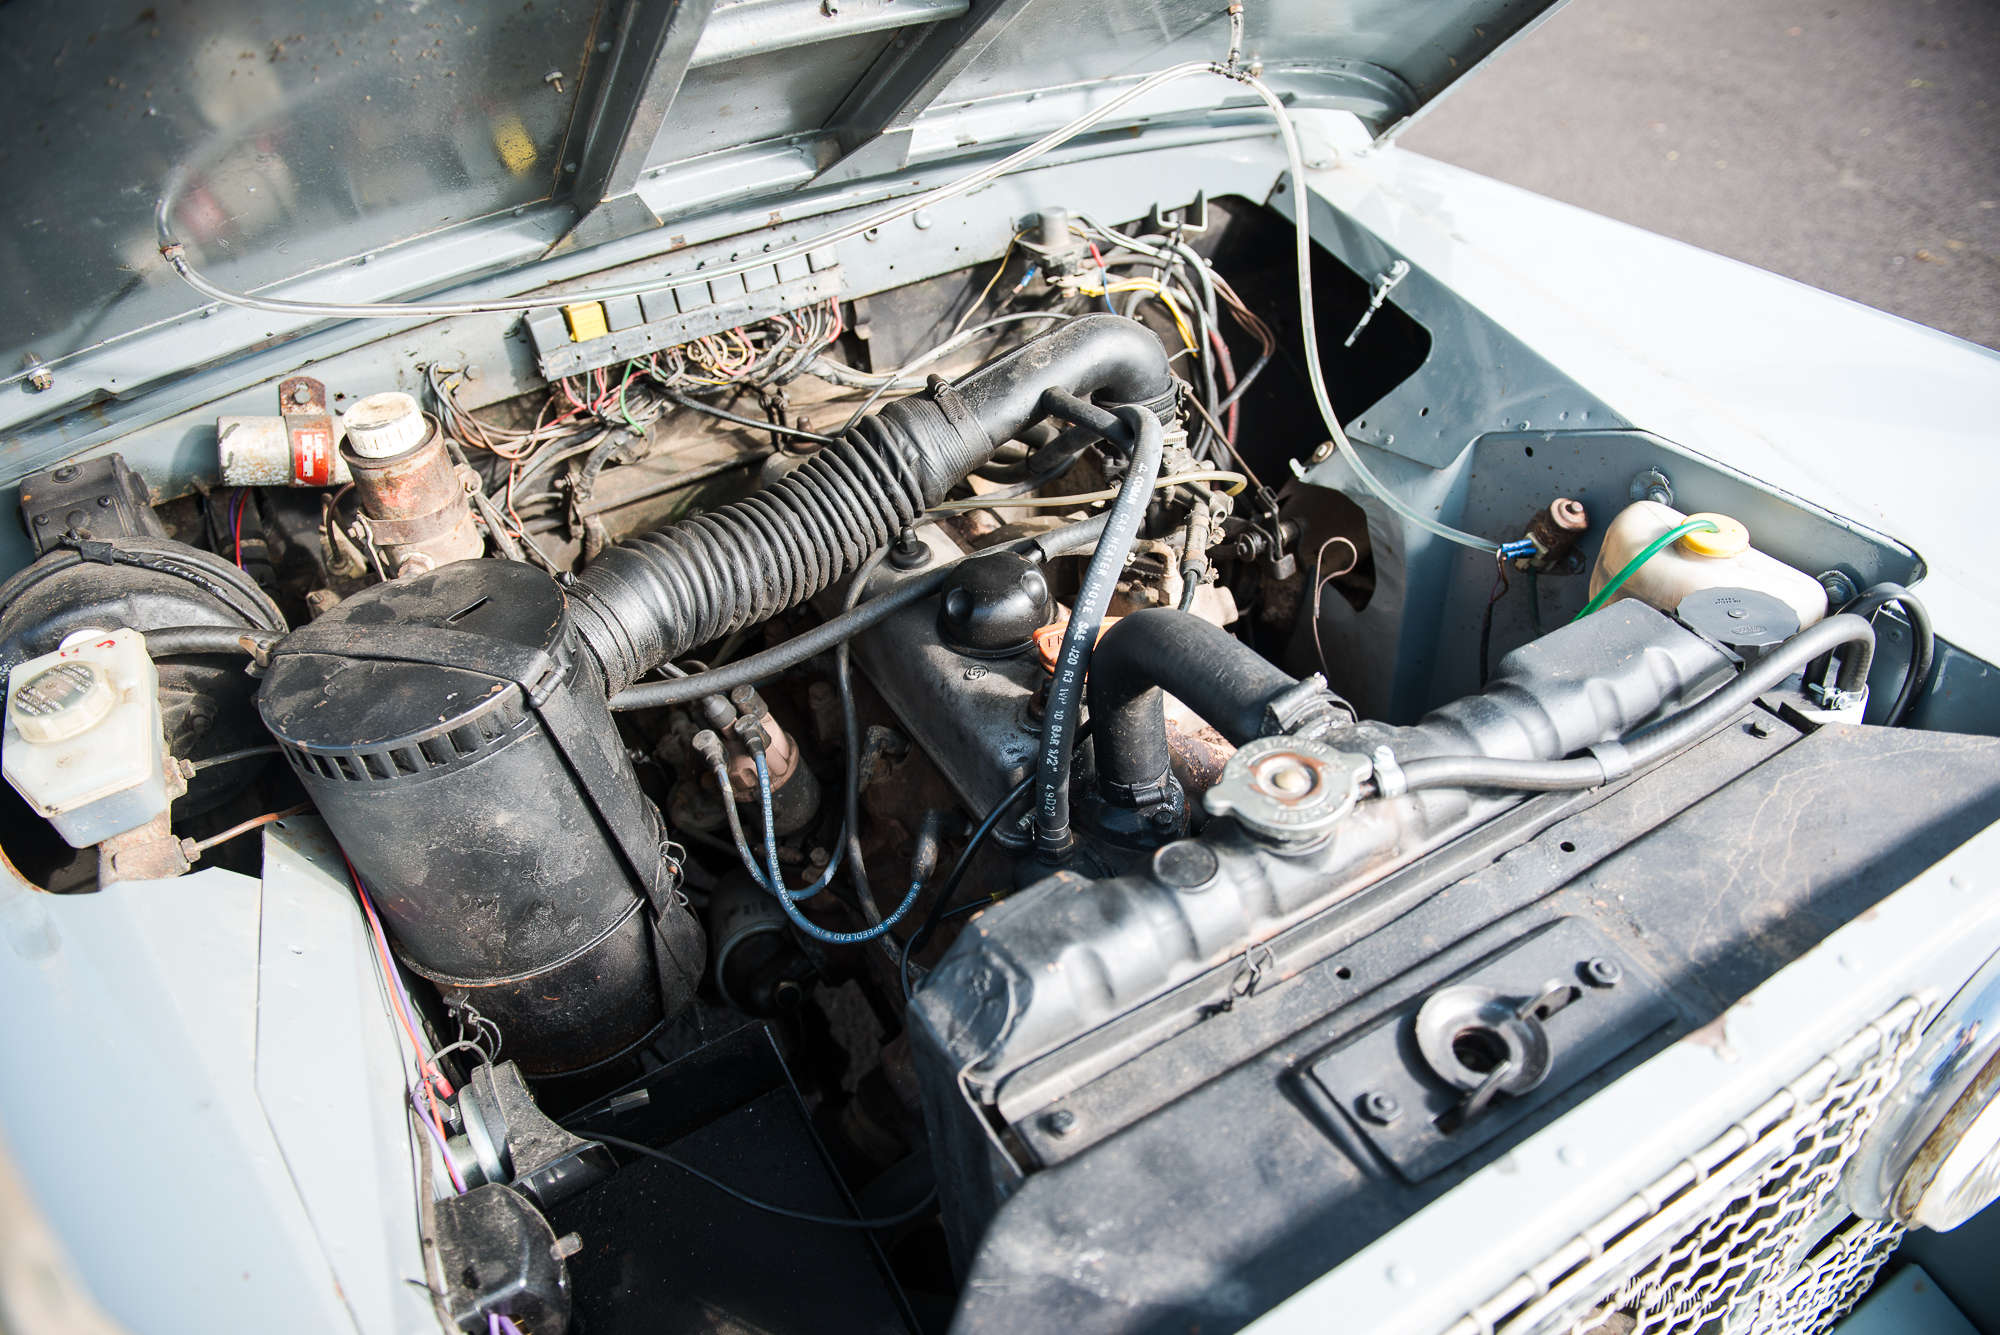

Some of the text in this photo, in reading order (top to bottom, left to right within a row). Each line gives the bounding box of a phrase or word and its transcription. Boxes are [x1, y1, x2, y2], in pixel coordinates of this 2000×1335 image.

[1116, 513, 1130, 534] CAR
[1097, 535, 1121, 577] HEATER
[1083, 582, 1101, 615] HOSE
[1073, 621, 1089, 641] SAE
[1049, 725, 1063, 746] BAR
[762, 787, 774, 838] SPEEDLEAD
[768, 841, 783, 881] SILICONE
[885, 892, 917, 926] SILICONE
[834, 924, 884, 941] SPEEDLEAD
